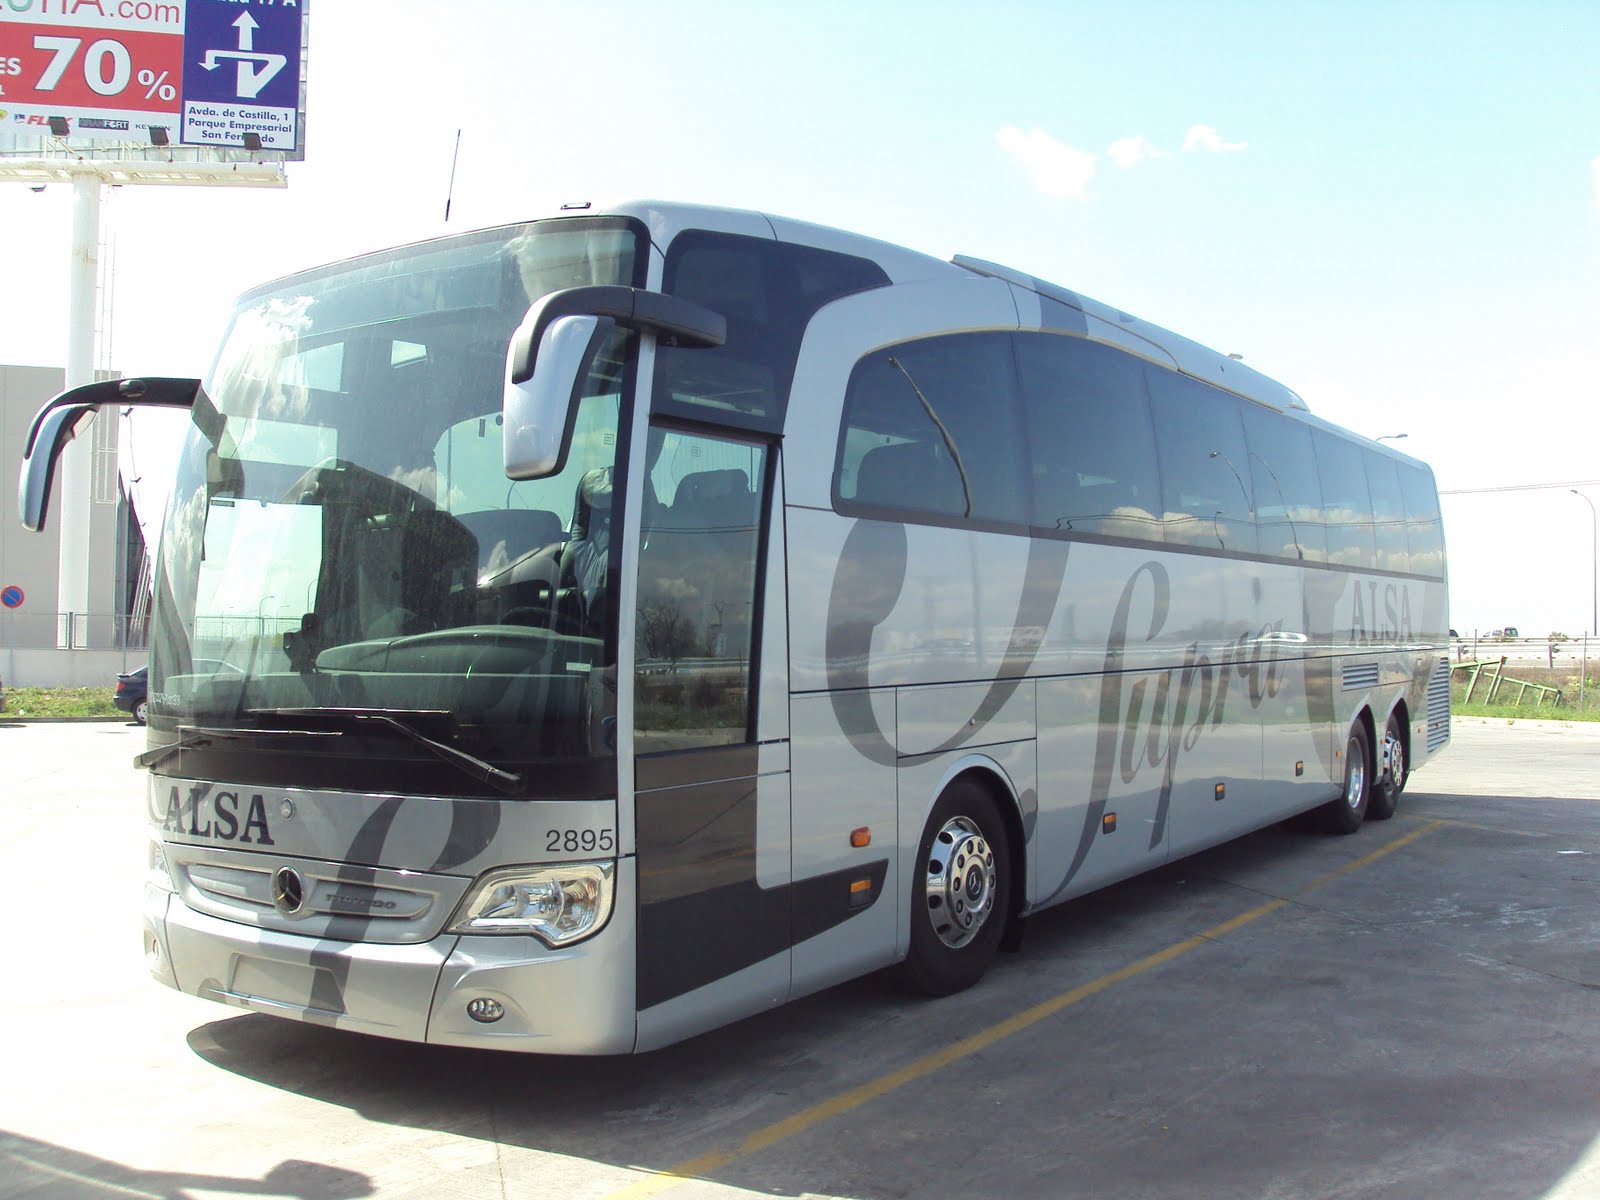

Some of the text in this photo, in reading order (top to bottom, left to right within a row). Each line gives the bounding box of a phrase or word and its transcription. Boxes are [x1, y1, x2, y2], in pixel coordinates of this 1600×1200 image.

[32, 34, 177, 101] 70%
[27, 114, 74, 128] FLX
[188, 106, 289, 122] Avda. de Castilla, 1
[188, 117, 292, 133] Parque Empresarial
[201, 129, 275, 143] San Ferdo
[1348, 580, 1414, 646] ALSA
[163, 785, 275, 846] ALSA
[546, 829, 613, 852] 2895
